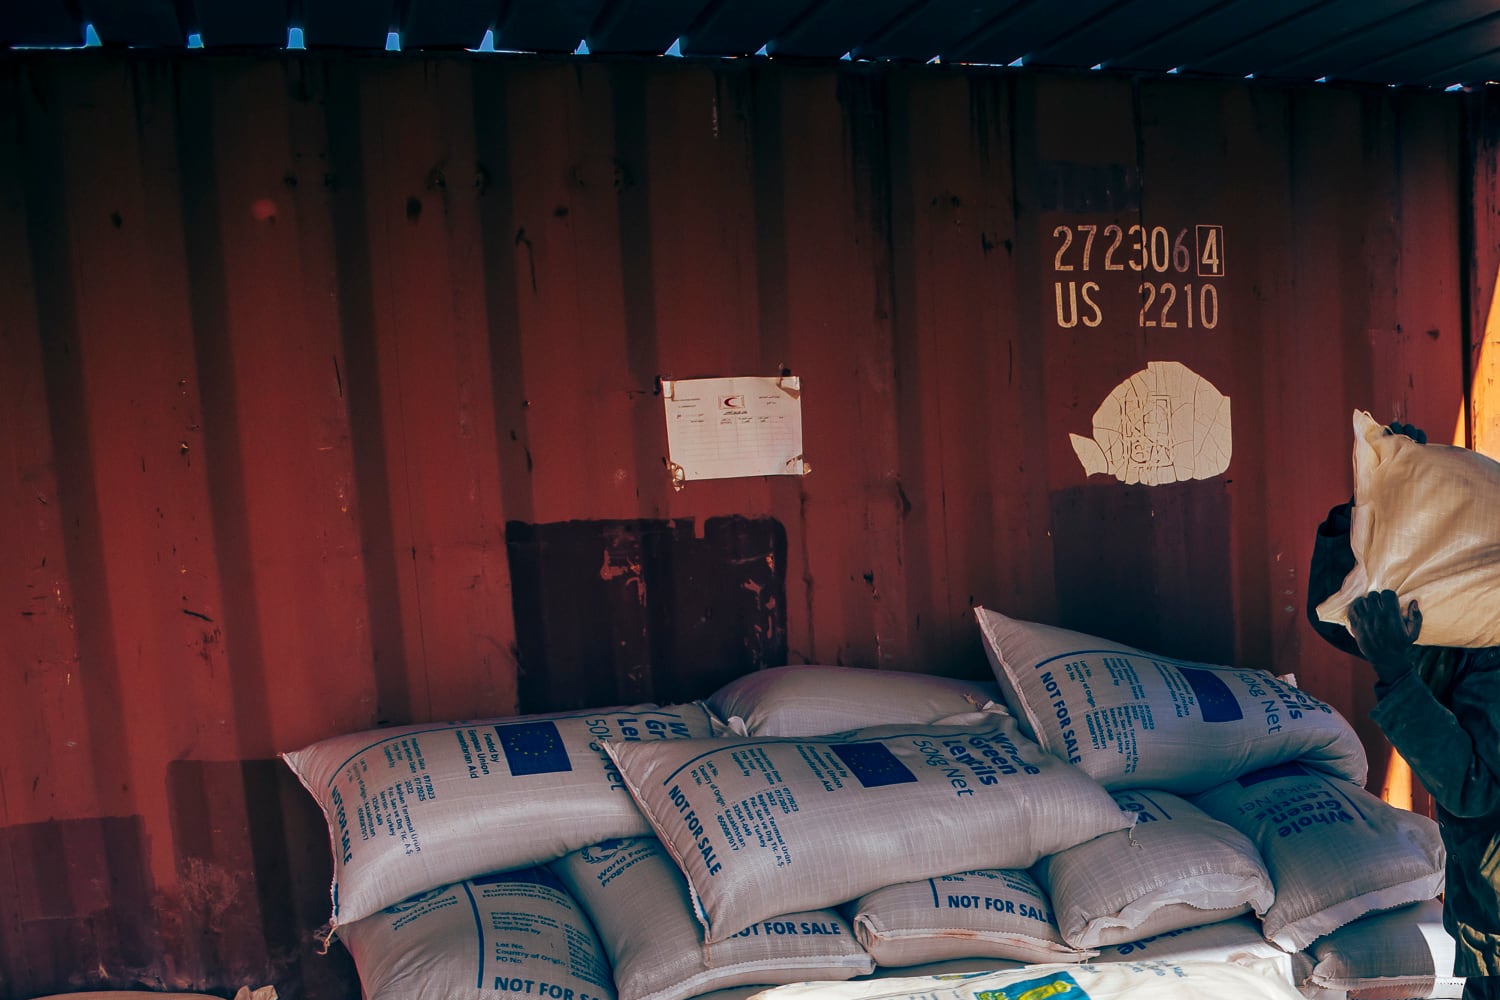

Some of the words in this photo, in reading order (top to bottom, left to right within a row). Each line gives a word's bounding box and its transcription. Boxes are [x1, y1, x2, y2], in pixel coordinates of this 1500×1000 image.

[1052, 224, 1190, 272] 272306
[1201, 228, 1220, 274] 4
[1054, 281, 1103, 328] US
[1138, 282, 1219, 330] 2210
[1040, 672, 1061, 699] NOT
[1053, 700, 1072, 730] FOR
[1063, 729, 1082, 765] SALE
[1175, 704, 1183, 718] Aid
[1261, 700, 1282, 735] Net
[645, 720, 666, 740] Gr
[478, 753, 490, 775] Union
[490, 754, 499, 762] by
[912, 740, 950, 766] 50kg
[940, 768, 974, 798] Net
[942, 740, 998, 786] Lentils
[968, 736, 1018, 775] Green
[468, 766, 479, 779] Aid
[822, 780, 834, 792] Aid
[827, 770, 843, 788] Union
[706, 760, 714, 769] Lot
[733, 804, 752, 836] 32541-049
[764, 772, 774, 785] Date
[774, 790, 790, 814] 07/2025
[766, 792, 777, 806] 2022
[773, 770, 782, 782] Date
[783, 788, 799, 812] 07/2023
[1255, 790, 1333, 820] Lentils
[690, 770, 698, 778] PO
[717, 815, 739, 850] 4500087017
[698, 765, 712, 784] Country
[714, 789, 726, 807] Origin
[725, 809, 746, 847] Kazakhstan
[755, 809, 764, 821] San
[761, 821, 768, 830] ve
[1272, 800, 1342, 824] Green
[331, 785, 343, 808] NOT
[337, 806, 347, 830] FOR
[342, 830, 353, 866] SALE
[386, 814, 395, 836] Turkey
[668, 784, 690, 814] NOT
[684, 810, 704, 840] FOR
[698, 836, 722, 876] SALE
[742, 800, 754, 820] Mersin
[754, 824, 767, 848] Turkey
[1277, 810, 1355, 838] Whole
[597, 856, 626, 880] World
[392, 906, 425, 926] World
[427, 896, 457, 908] Food
[947, 895, 980, 908] NOT
[984, 897, 1016, 914] FOR
[732, 922, 759, 938] OT
[763, 922, 798, 935] FOR
[800, 922, 841, 935] SALE
[496, 948, 529, 958] Country
[494, 976, 535, 994] NOT
